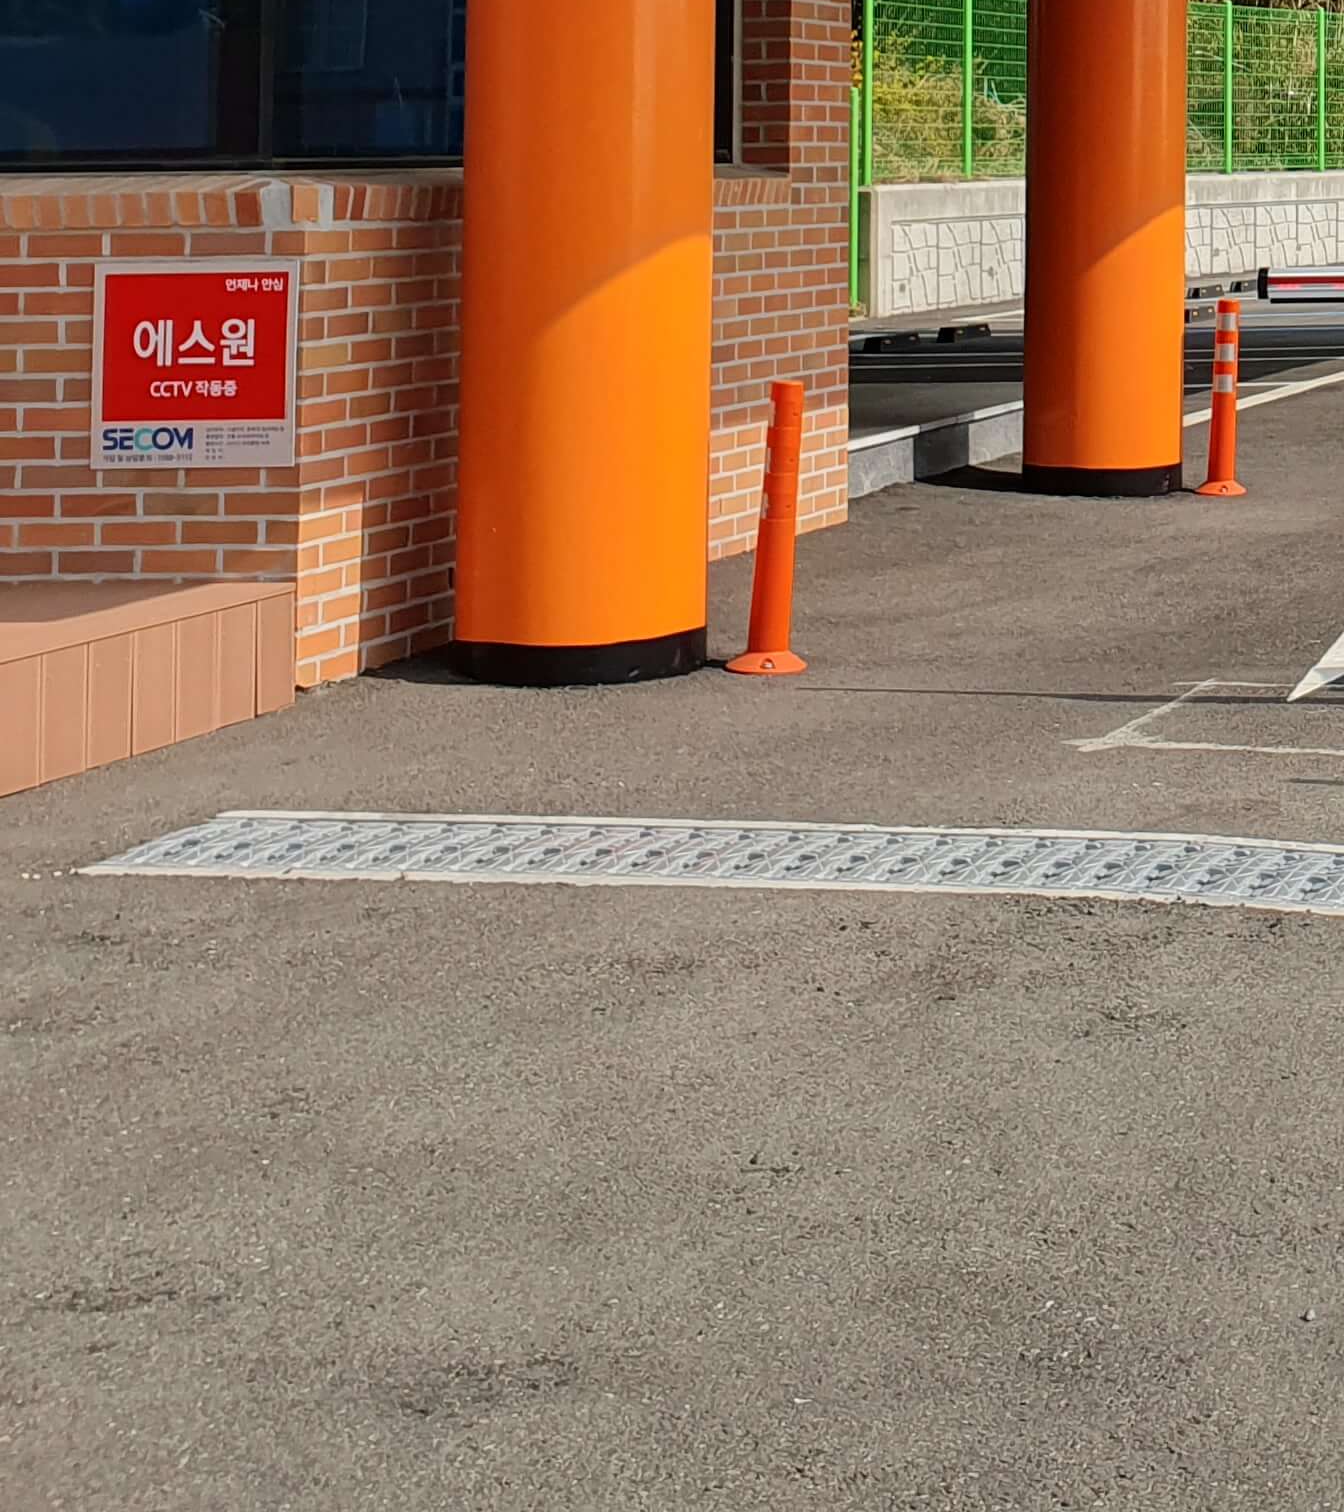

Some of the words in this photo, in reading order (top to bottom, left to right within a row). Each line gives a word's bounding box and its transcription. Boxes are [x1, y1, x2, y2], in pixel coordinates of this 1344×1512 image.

[225, 278, 258, 292] 언제나
[261, 278, 284, 292] 안심
[133, 318, 256, 367] 에스원
[150, 380, 193, 397] CCTV
[195, 380, 238, 397] 작동중
[102, 427, 194, 451] SECOM
